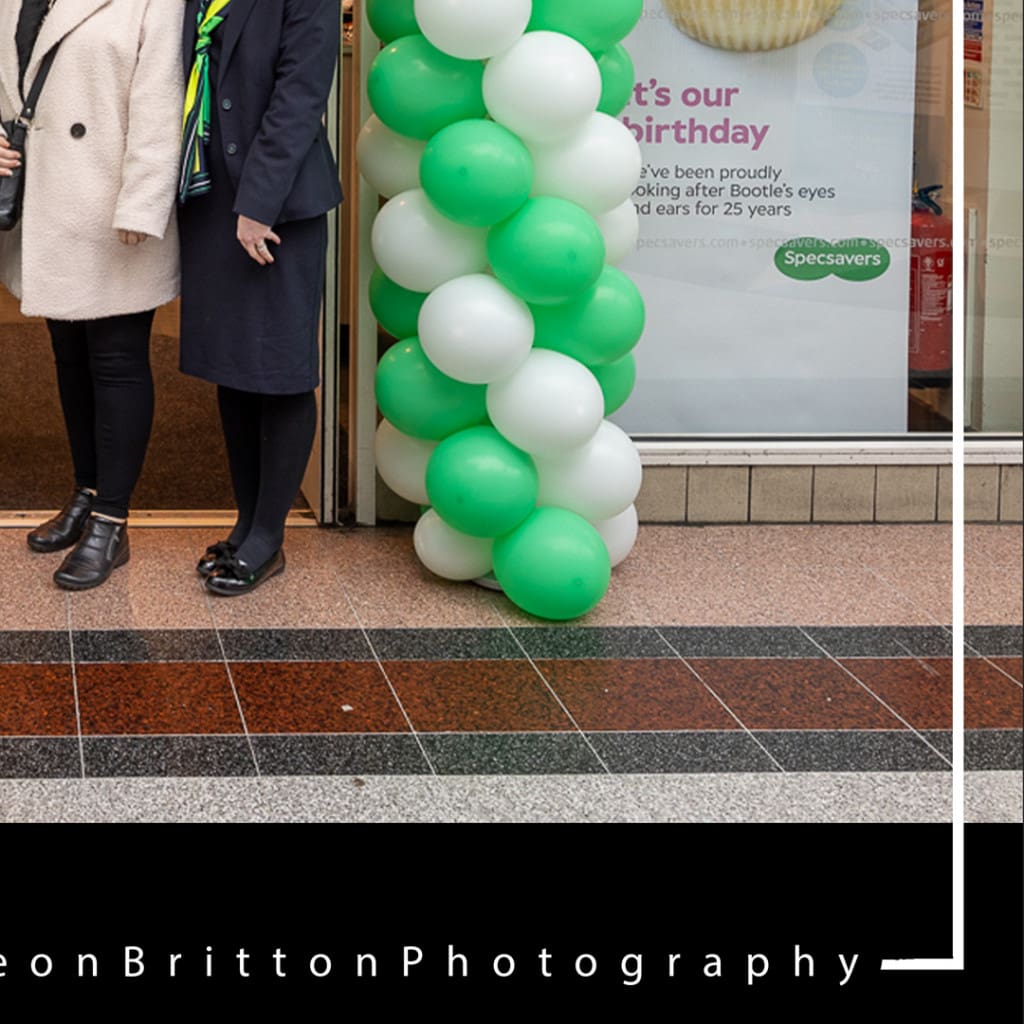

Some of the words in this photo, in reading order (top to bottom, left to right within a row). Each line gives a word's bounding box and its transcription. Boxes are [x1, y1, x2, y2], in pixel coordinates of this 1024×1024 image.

[633, 79, 672, 107] t's
[681, 87, 740, 107] our
[639, 164, 670, 179] e've
[675, 165, 714, 179] been
[719, 165, 782, 182] proudly
[631, 182, 681, 200] oking
[685, 183, 725, 198] after
[730, 183, 793, 198] Bootle's
[798, 186, 836, 201] eyes
[634, 201, 651, 216] nd
[656, 204, 690, 216] ears
[695, 201, 718, 216] for
[723, 202, 743, 216] 25
[748, 204, 792, 219] years
[636, 235, 738, 252] pecsavers.com
[783, 249, 882, 268] Specsavers
